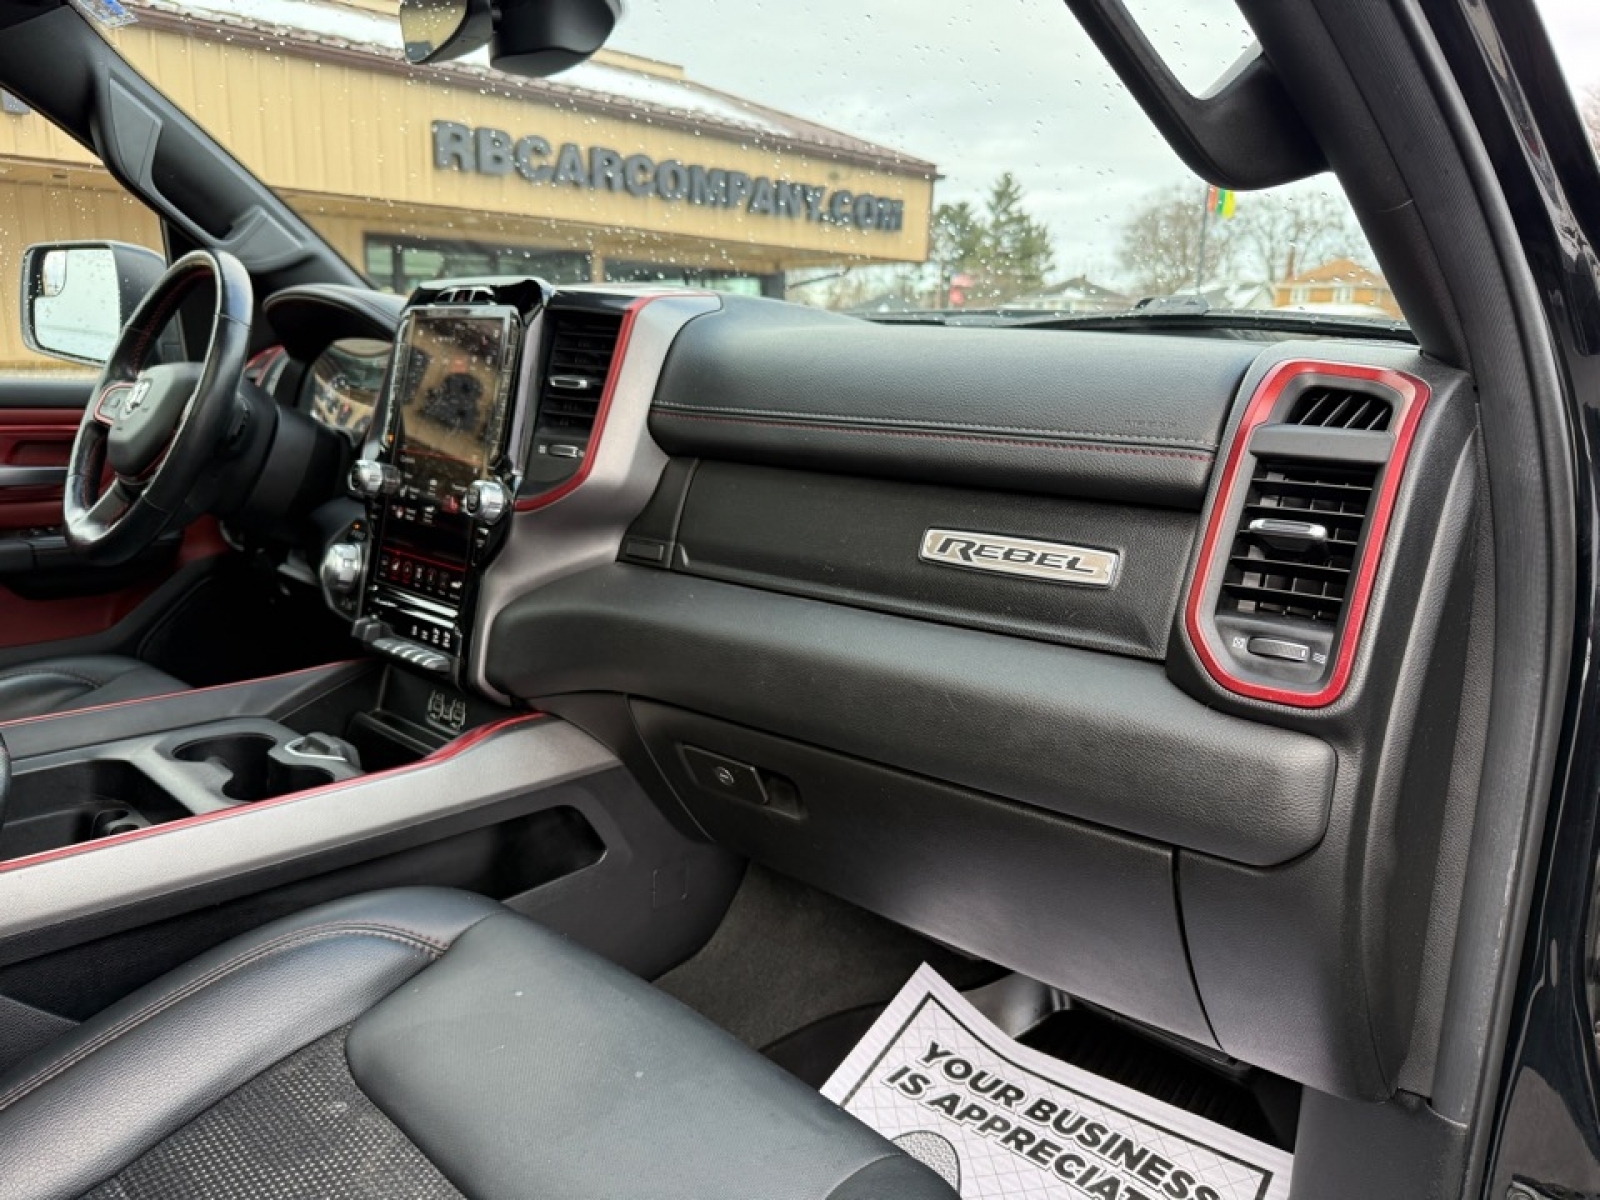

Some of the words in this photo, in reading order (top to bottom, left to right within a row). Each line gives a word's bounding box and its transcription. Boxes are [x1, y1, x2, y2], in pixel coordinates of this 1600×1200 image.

[432, 119, 904, 232] RBCARCOMPANY.COM
[936, 537, 1094, 573] REBEL
[886, 1065, 931, 1096] IS
[921, 1040, 1026, 1108] YOUR
